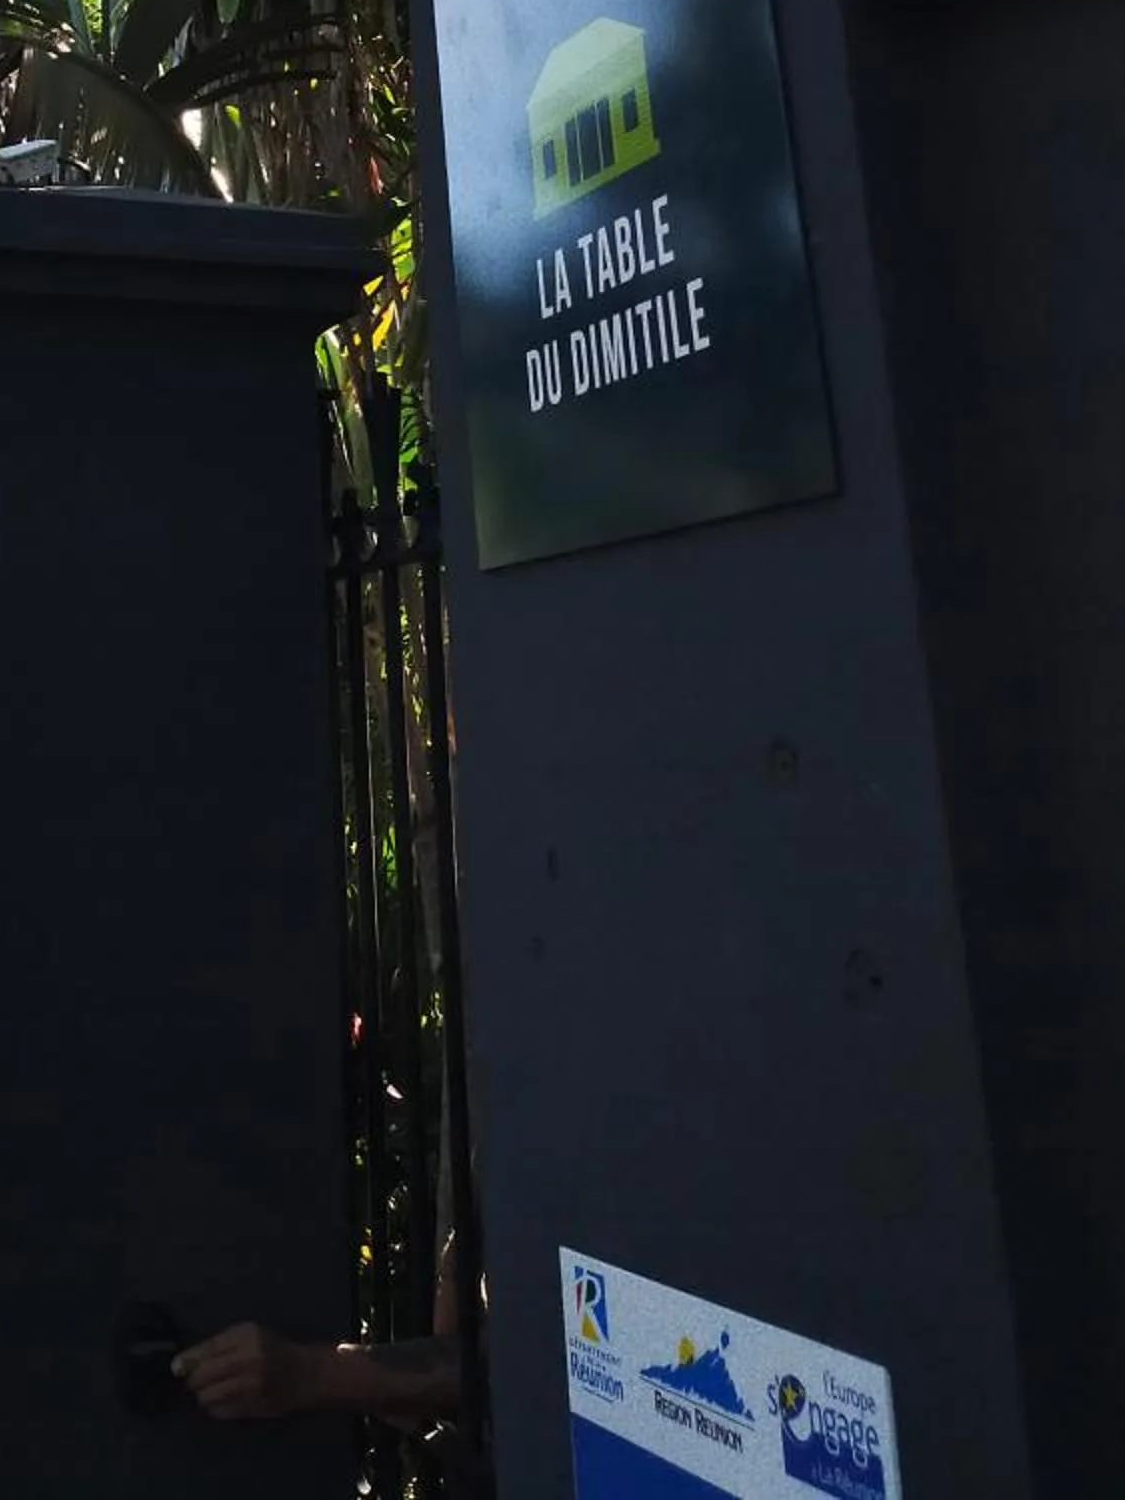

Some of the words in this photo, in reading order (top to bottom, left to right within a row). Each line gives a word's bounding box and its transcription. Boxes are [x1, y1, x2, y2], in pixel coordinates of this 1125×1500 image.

[536, 248, 573, 320] LA
[578, 194, 675, 300] TABLE
[526, 340, 563, 413] DU
[570, 277, 711, 398] DIMITILE
